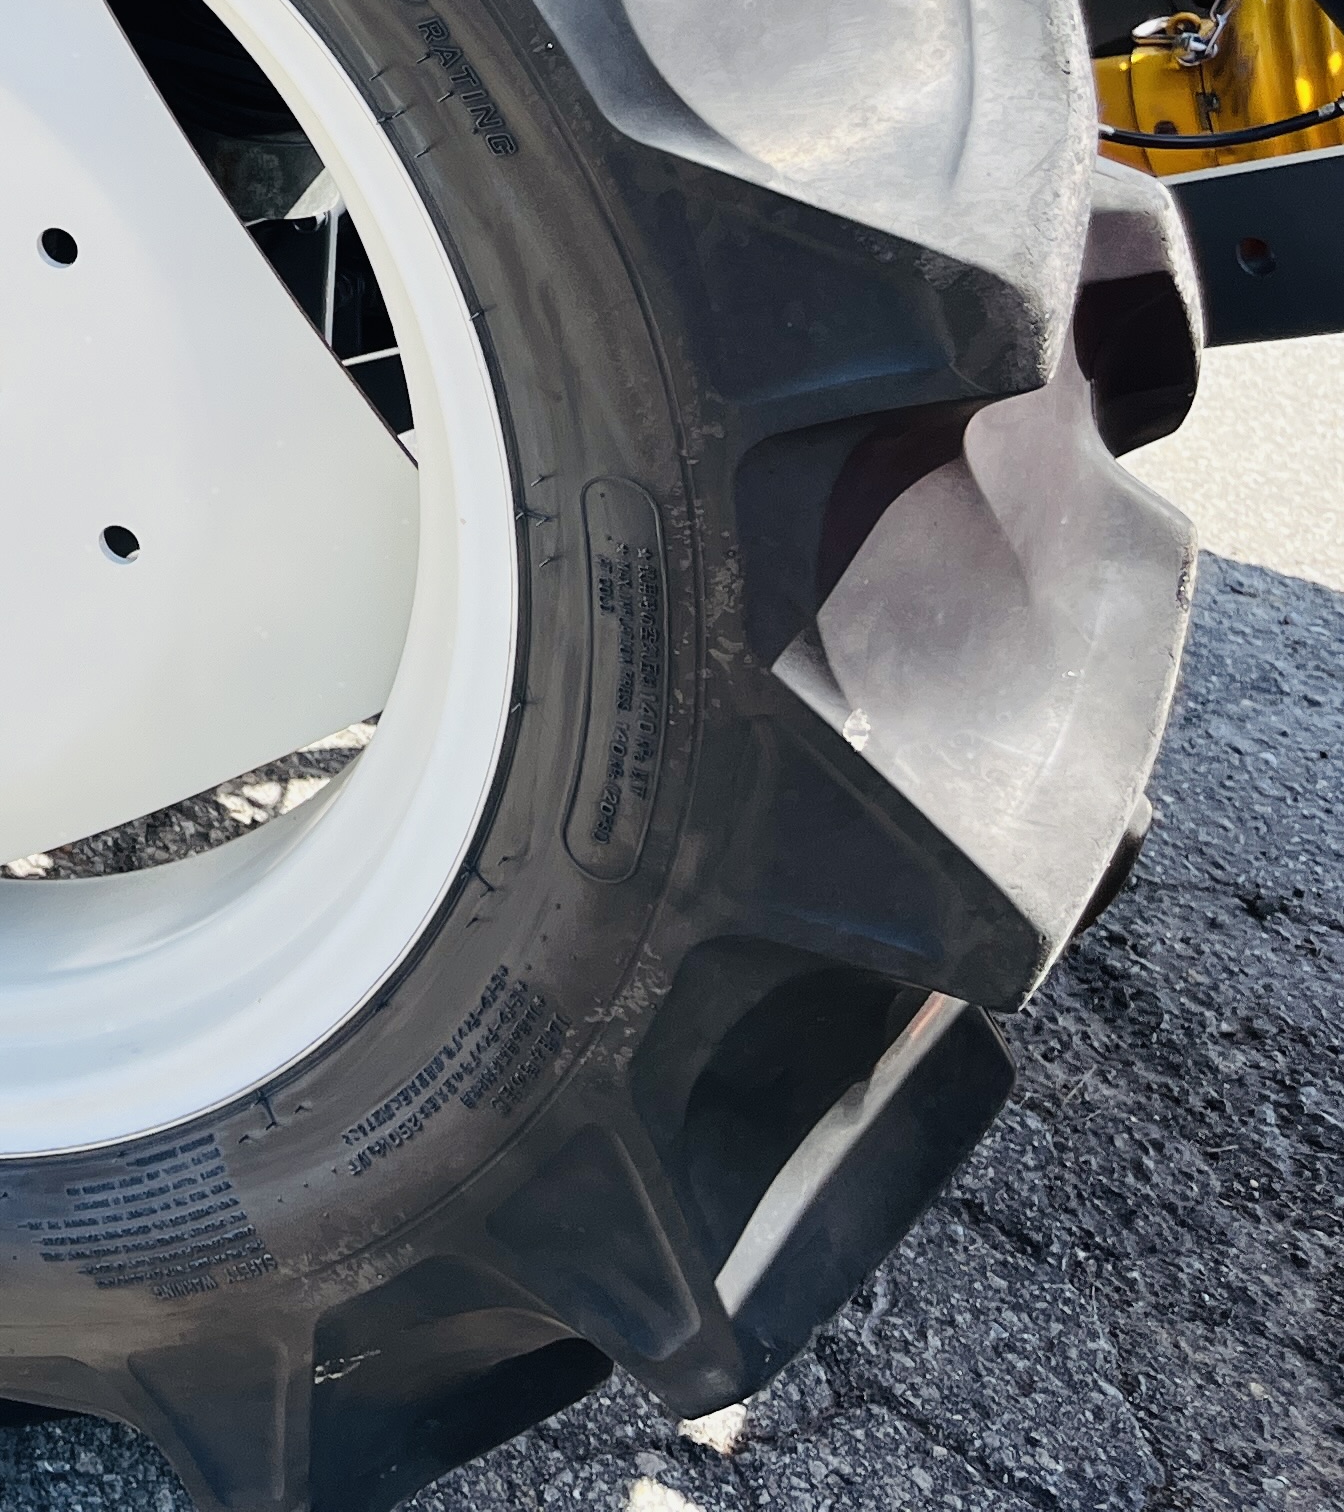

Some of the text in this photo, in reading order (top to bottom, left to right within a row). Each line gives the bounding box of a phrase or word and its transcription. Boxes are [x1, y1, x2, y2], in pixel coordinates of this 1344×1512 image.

[417, 17, 519, 157] RATING
[223, 1252, 278, 1285] SAFETY
[151, 1270, 217, 1302] WARNING
